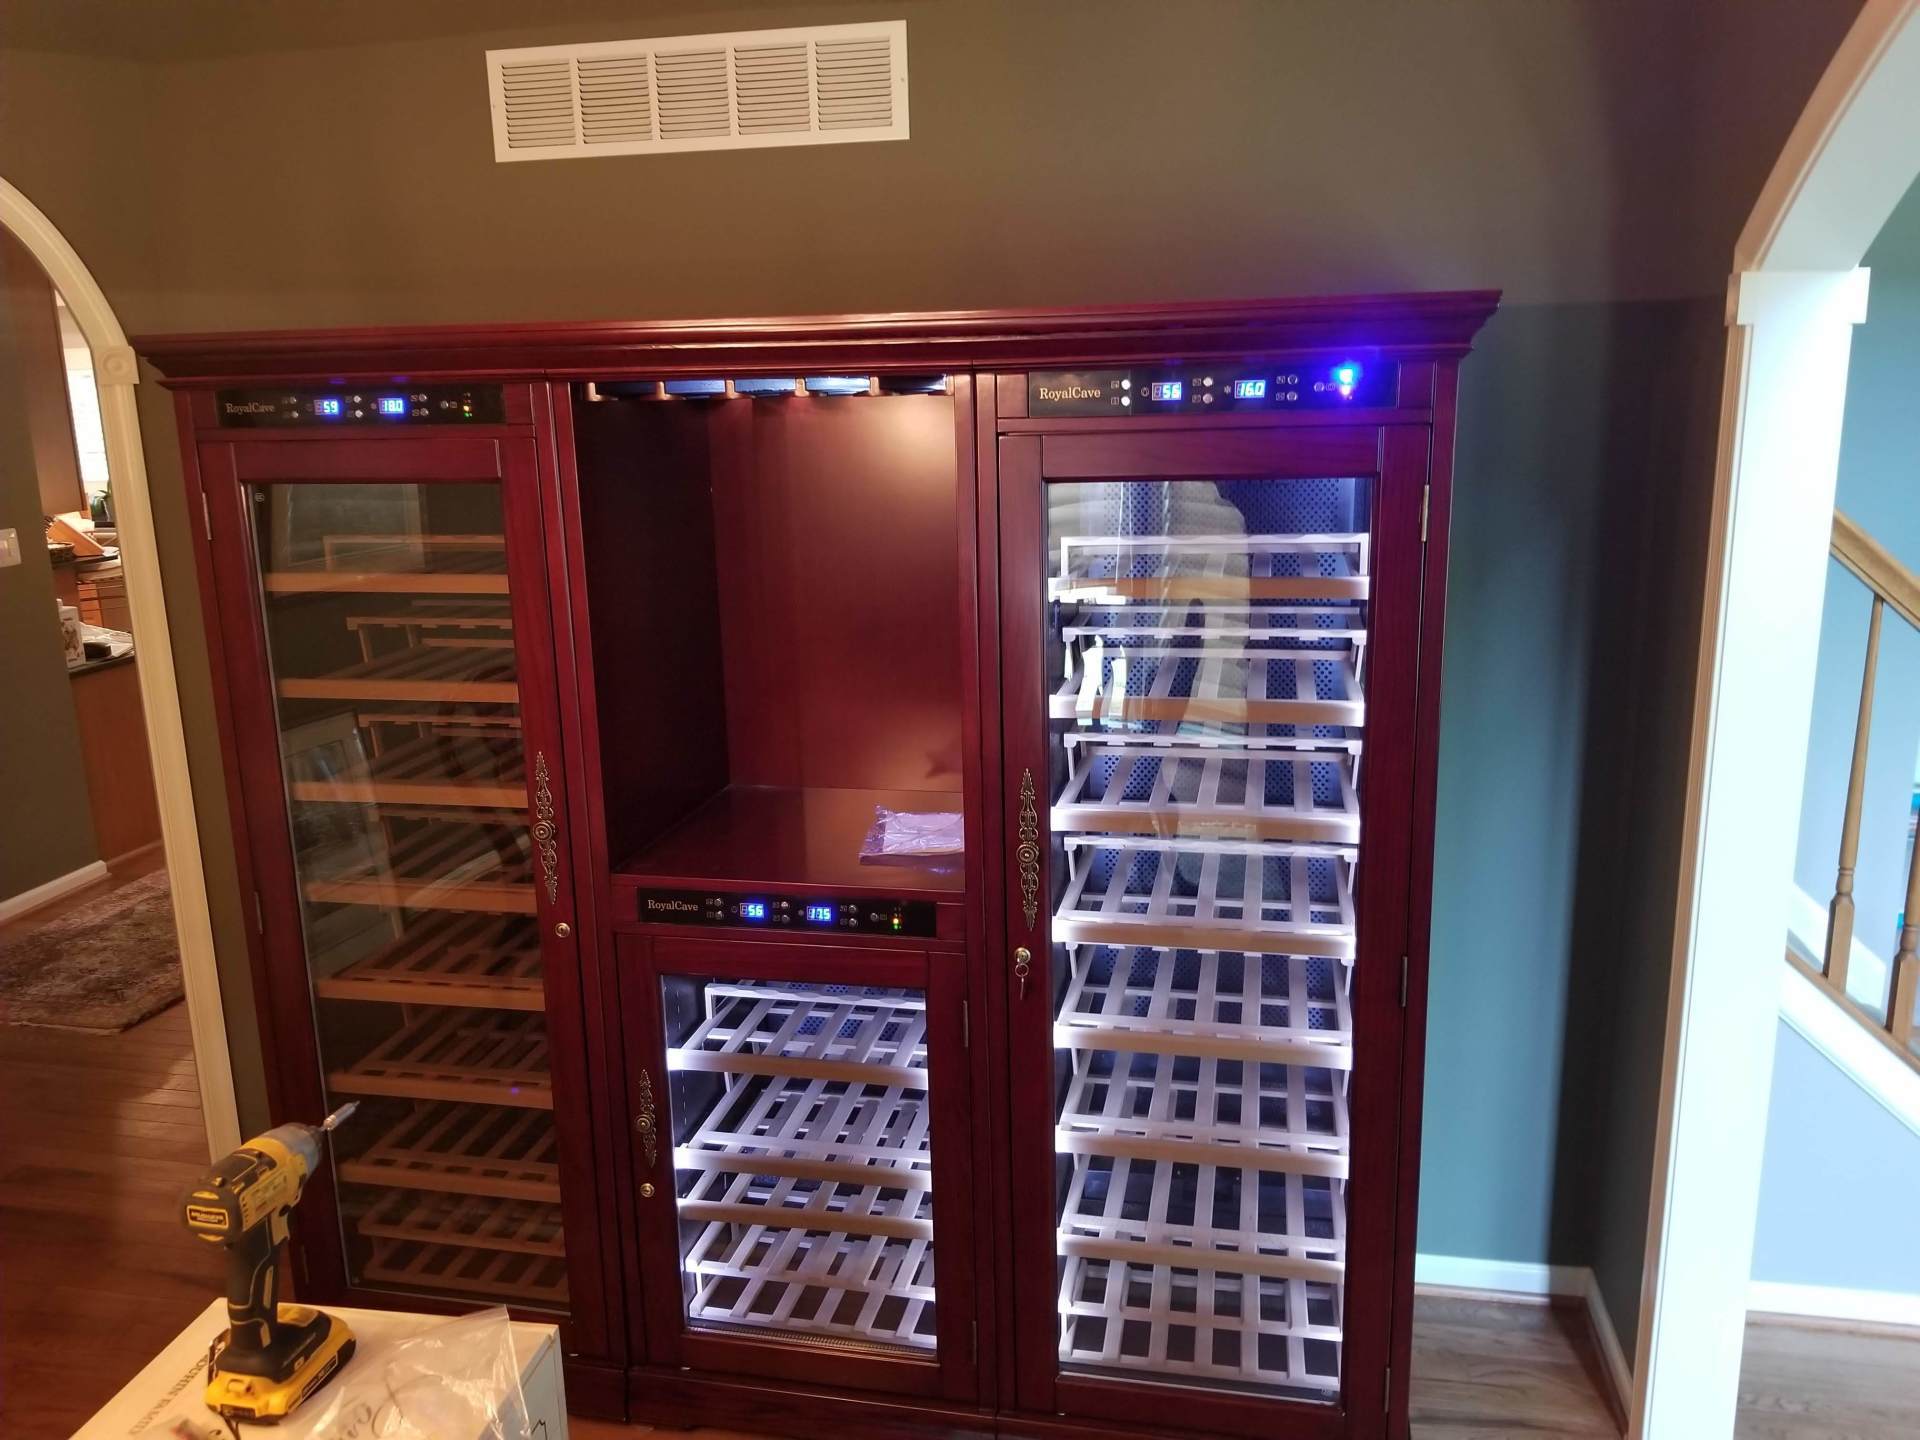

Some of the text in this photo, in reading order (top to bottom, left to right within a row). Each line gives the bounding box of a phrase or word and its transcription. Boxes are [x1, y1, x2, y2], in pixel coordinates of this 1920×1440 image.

[1039, 386, 1101, 400] RoyalCave
[1163, 384, 1180, 398] 56
[225, 403, 275, 415] RoyalCave
[324, 400, 338, 413] 59
[647, 900, 698, 912] RoyalCave
[748, 905, 763, 916] 56
